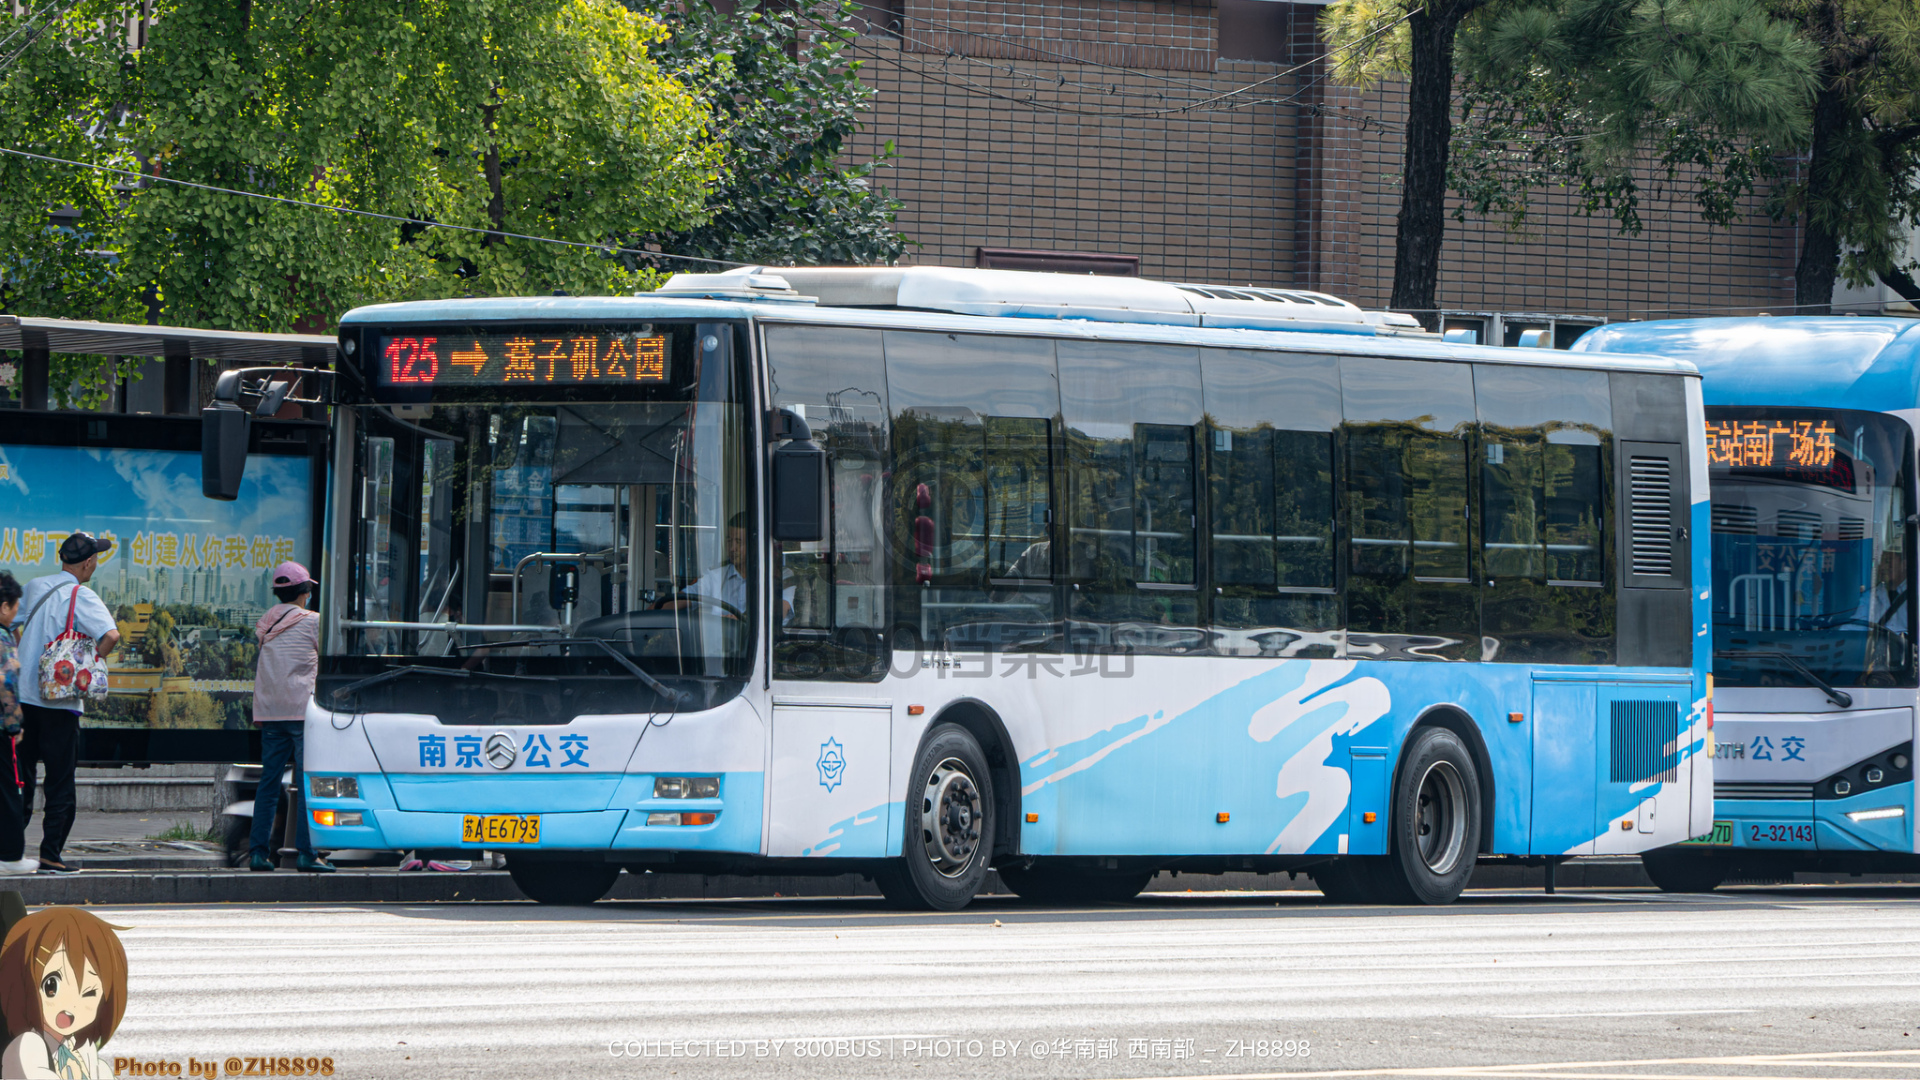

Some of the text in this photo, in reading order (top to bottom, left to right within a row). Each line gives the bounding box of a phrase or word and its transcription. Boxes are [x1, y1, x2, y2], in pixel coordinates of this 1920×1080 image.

[384, 335, 666, 383] 125 燕子矶公园
[418, 734, 590, 768] 南京 公交
[1750, 736, 1806, 762] 公交
[1751, 825, 1813, 842] 2-32143
